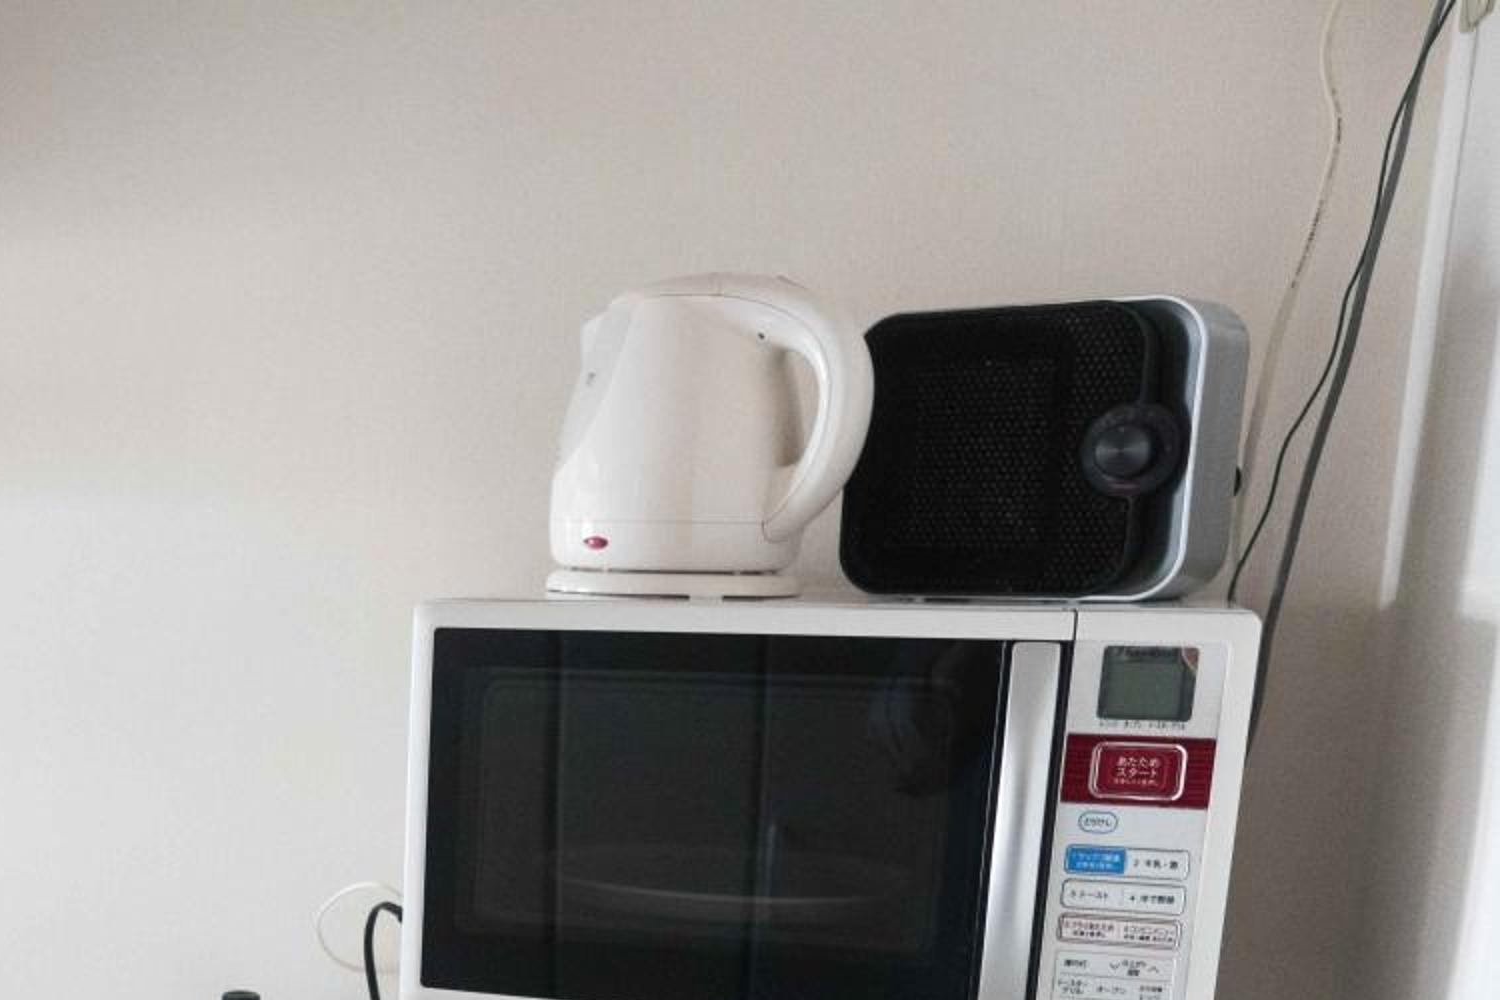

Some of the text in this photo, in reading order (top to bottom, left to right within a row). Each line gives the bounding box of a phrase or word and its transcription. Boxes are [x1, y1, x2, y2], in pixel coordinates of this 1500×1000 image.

[1116, 756, 1160, 768] あたため
[1116, 768, 1157, 779] スタート
